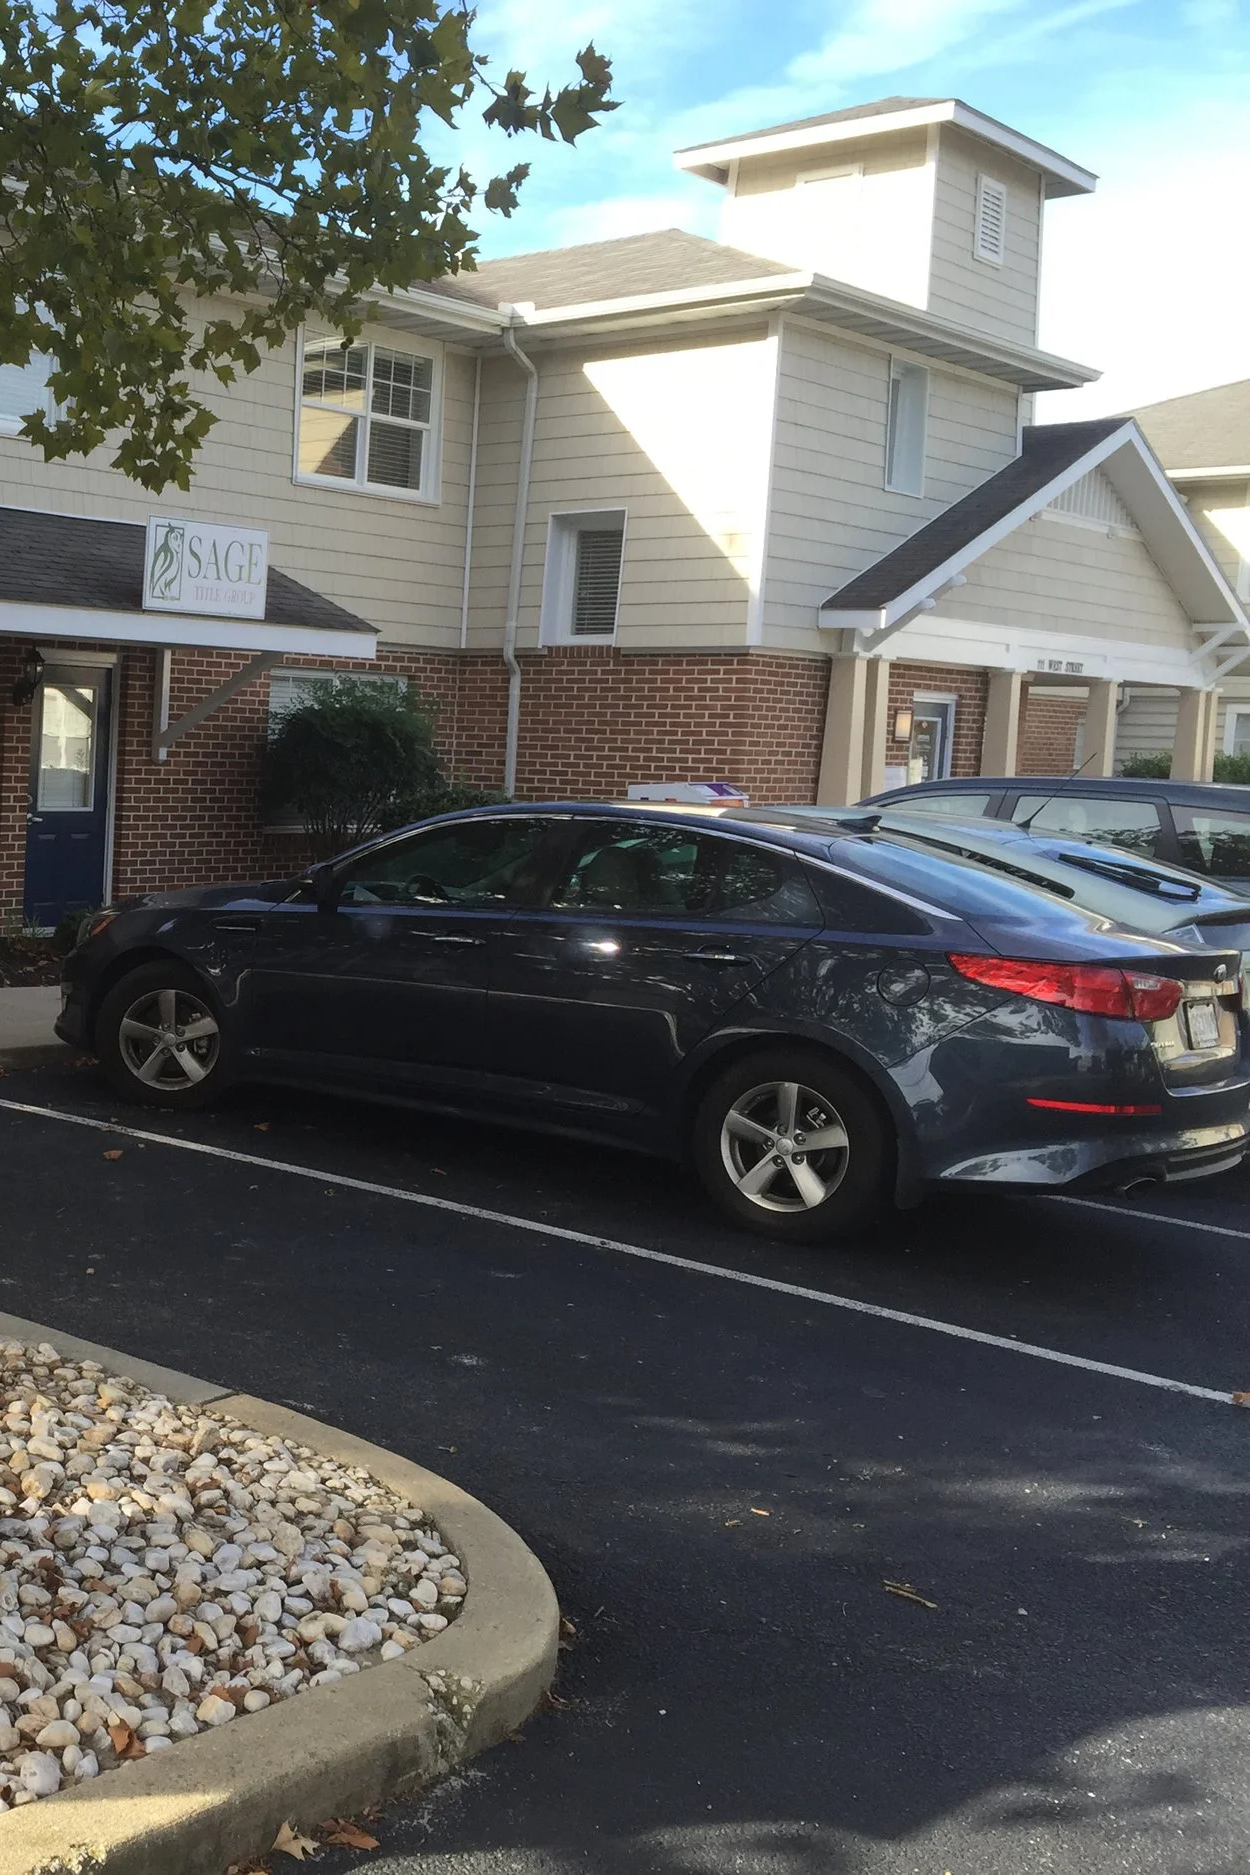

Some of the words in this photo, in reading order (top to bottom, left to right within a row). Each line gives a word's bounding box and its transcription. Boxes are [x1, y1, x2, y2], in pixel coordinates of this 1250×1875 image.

[187, 535, 263, 585] SAGE
[195, 586, 222, 602] TITLE
[224, 588, 256, 605] GROUP
[1049, 659, 1063, 672] WEST
[1065, 661, 1084, 674] STREET
